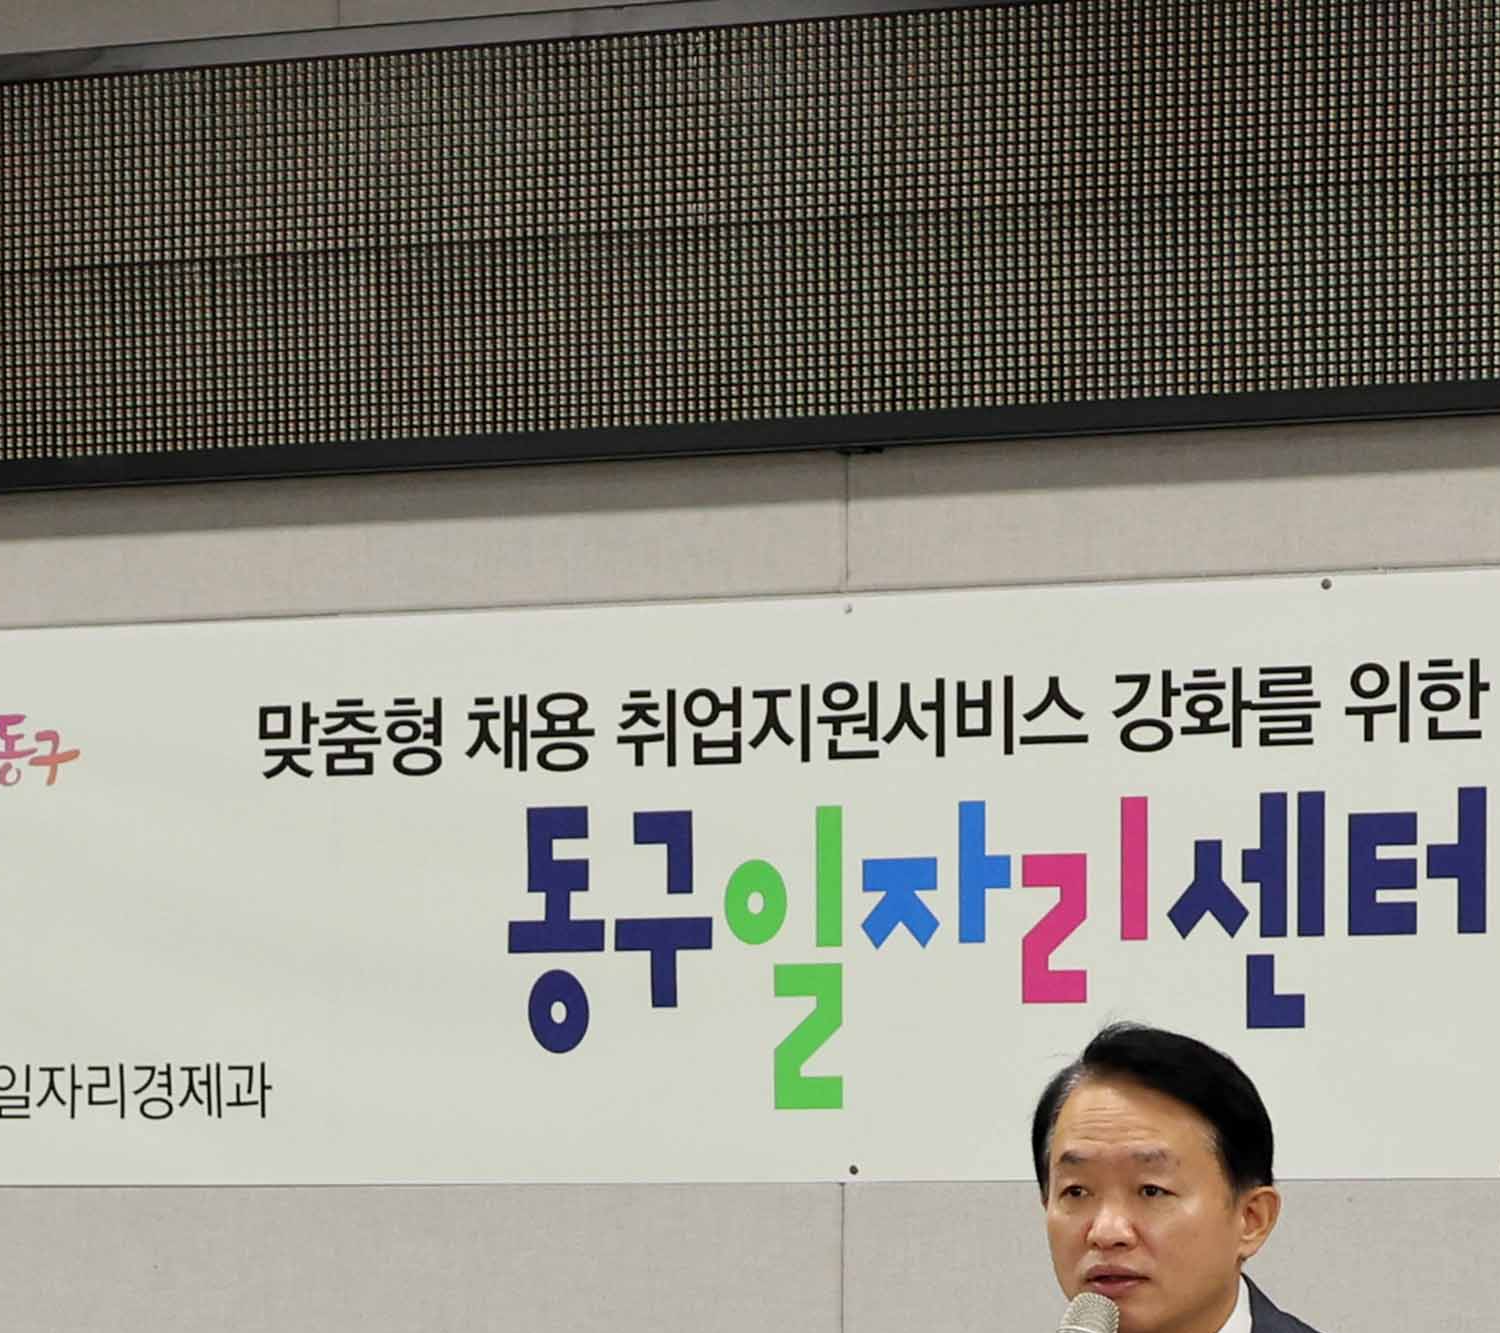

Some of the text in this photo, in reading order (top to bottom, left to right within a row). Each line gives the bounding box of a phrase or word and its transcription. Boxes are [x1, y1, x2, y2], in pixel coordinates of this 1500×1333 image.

[258, 658, 1492, 782] 맞춤형 채용 취업지원서비스 강화를 위한
